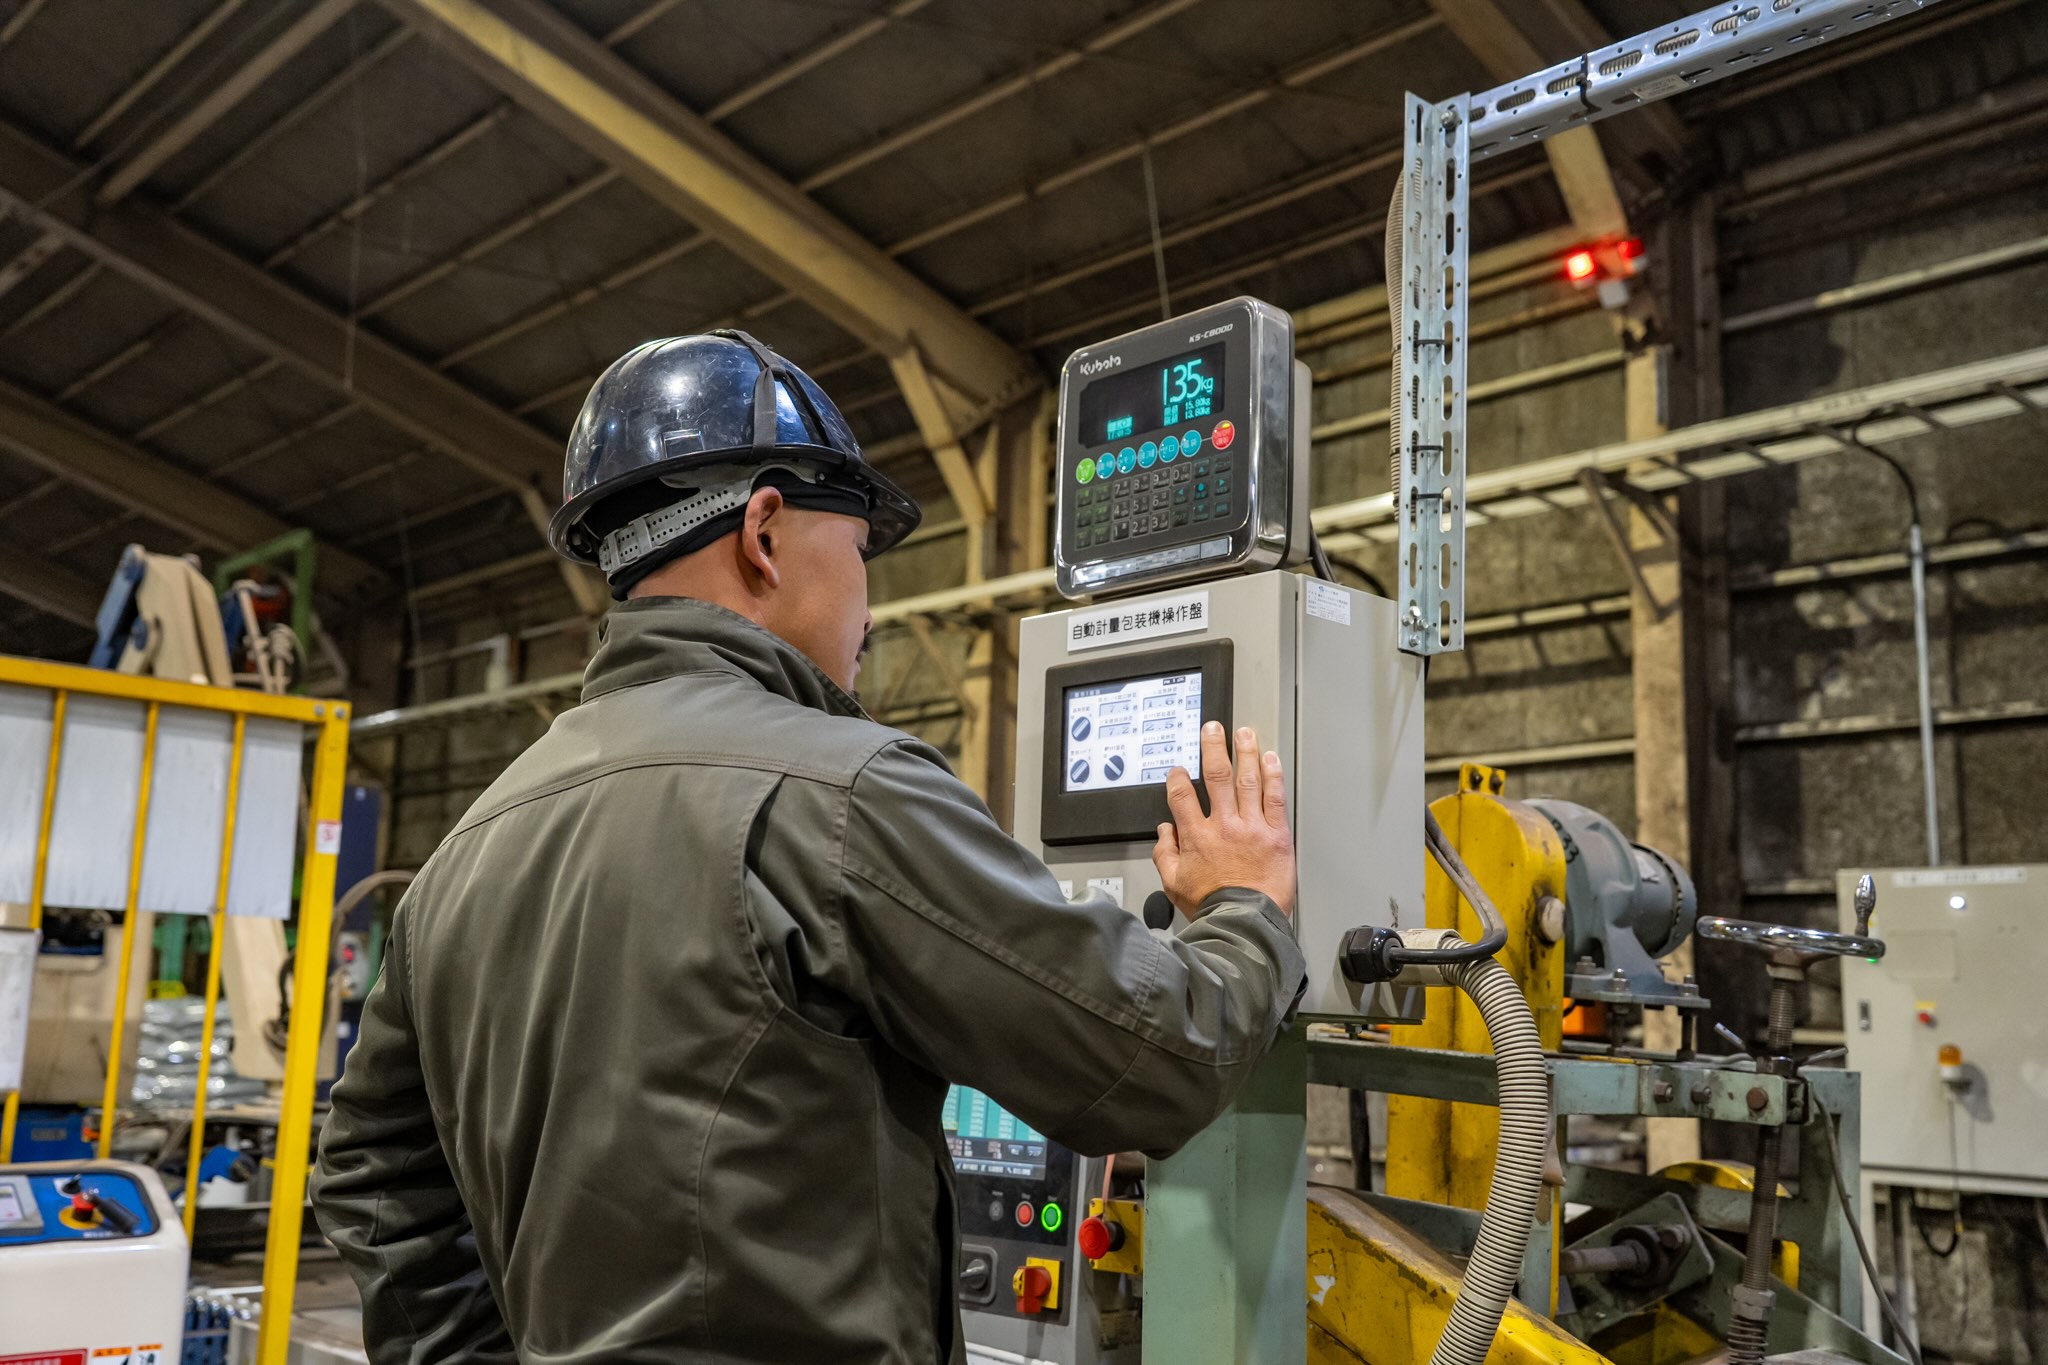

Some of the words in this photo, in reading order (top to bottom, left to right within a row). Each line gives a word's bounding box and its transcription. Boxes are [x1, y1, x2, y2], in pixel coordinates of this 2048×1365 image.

[1189, 323, 1233, 343] KS-C8000
[1080, 355, 1121, 375] Kubota
[1114, 484, 1121, 495] 7
[1153, 474, 1159, 486] 9
[1113, 505, 1120, 514] 4
[1133, 500, 1139, 511] 5
[1153, 495, 1159, 506] 6
[1132, 521, 1138, 533] 2
[1152, 516, 1158, 528] 3
[1073, 602, 1202, 639] 自動計量包装機操作盤
[1145, 720, 1174, 731] 2.5
[1145, 743, 1173, 755] 2.0
